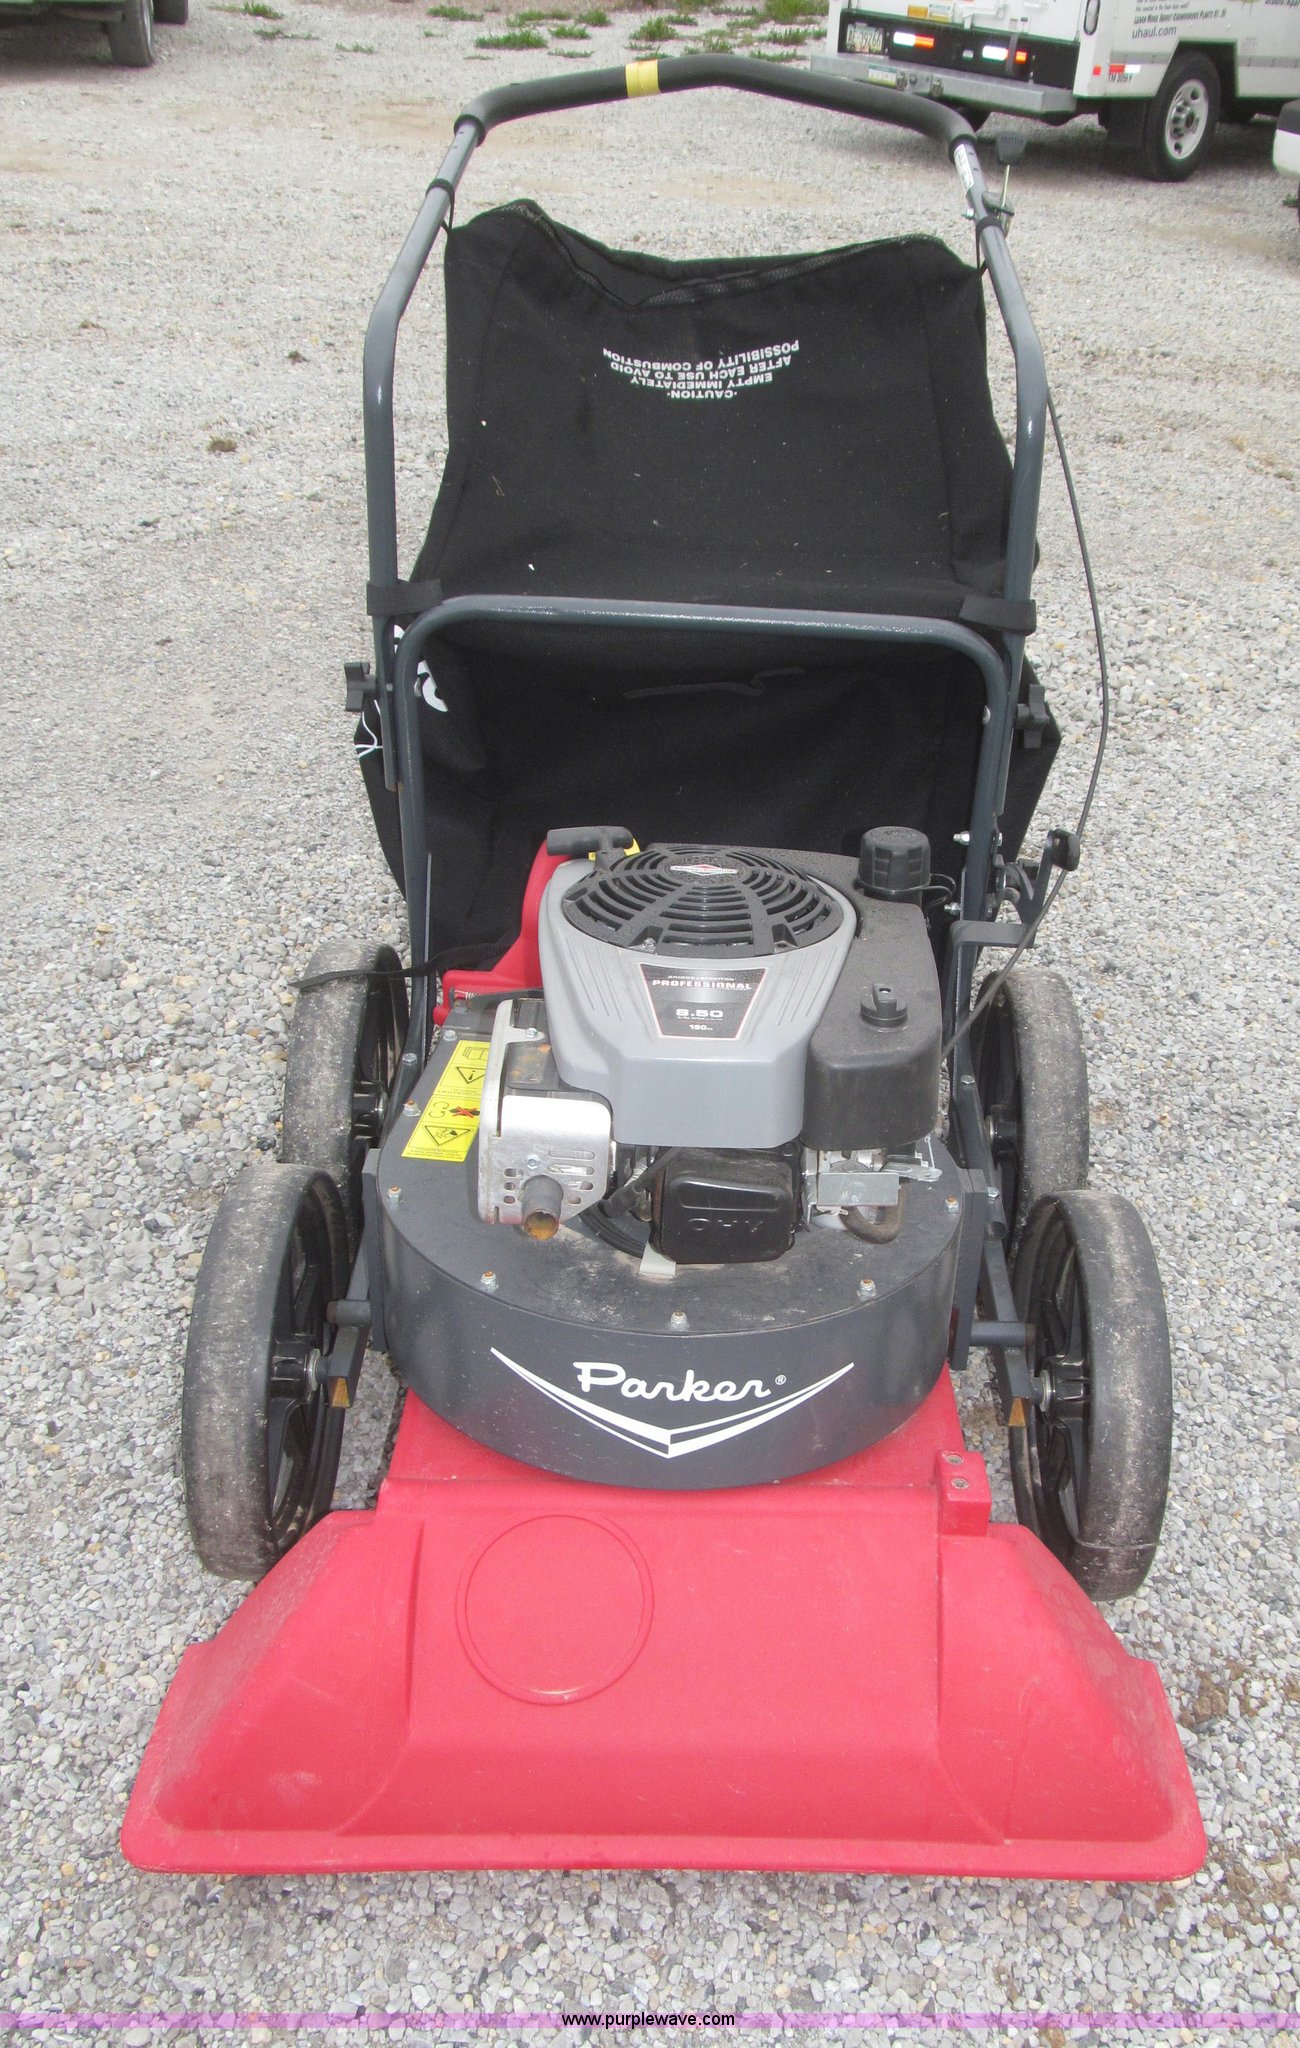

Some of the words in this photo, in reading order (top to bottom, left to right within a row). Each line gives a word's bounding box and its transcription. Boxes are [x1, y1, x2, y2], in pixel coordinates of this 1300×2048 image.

[1132, 25, 1177, 39] uhaul.com
[603, 347, 692, 371] COMBUSTION
[717, 340, 800, 369] POSSIBILITY
[610, 361, 650, 378] AVOID
[695, 361, 714, 372] OF
[709, 365, 745, 378] EACH
[749, 355, 792, 374] AFTER
[630, 376, 722, 389] IMMEDIATELY
[654, 371, 673, 380] TO
[677, 371, 705, 380] USE
[727, 372, 773, 389] EMPTY
[652, 979, 753, 991] PROFESSIONAL
[572, 1361, 772, 1402] Parker
